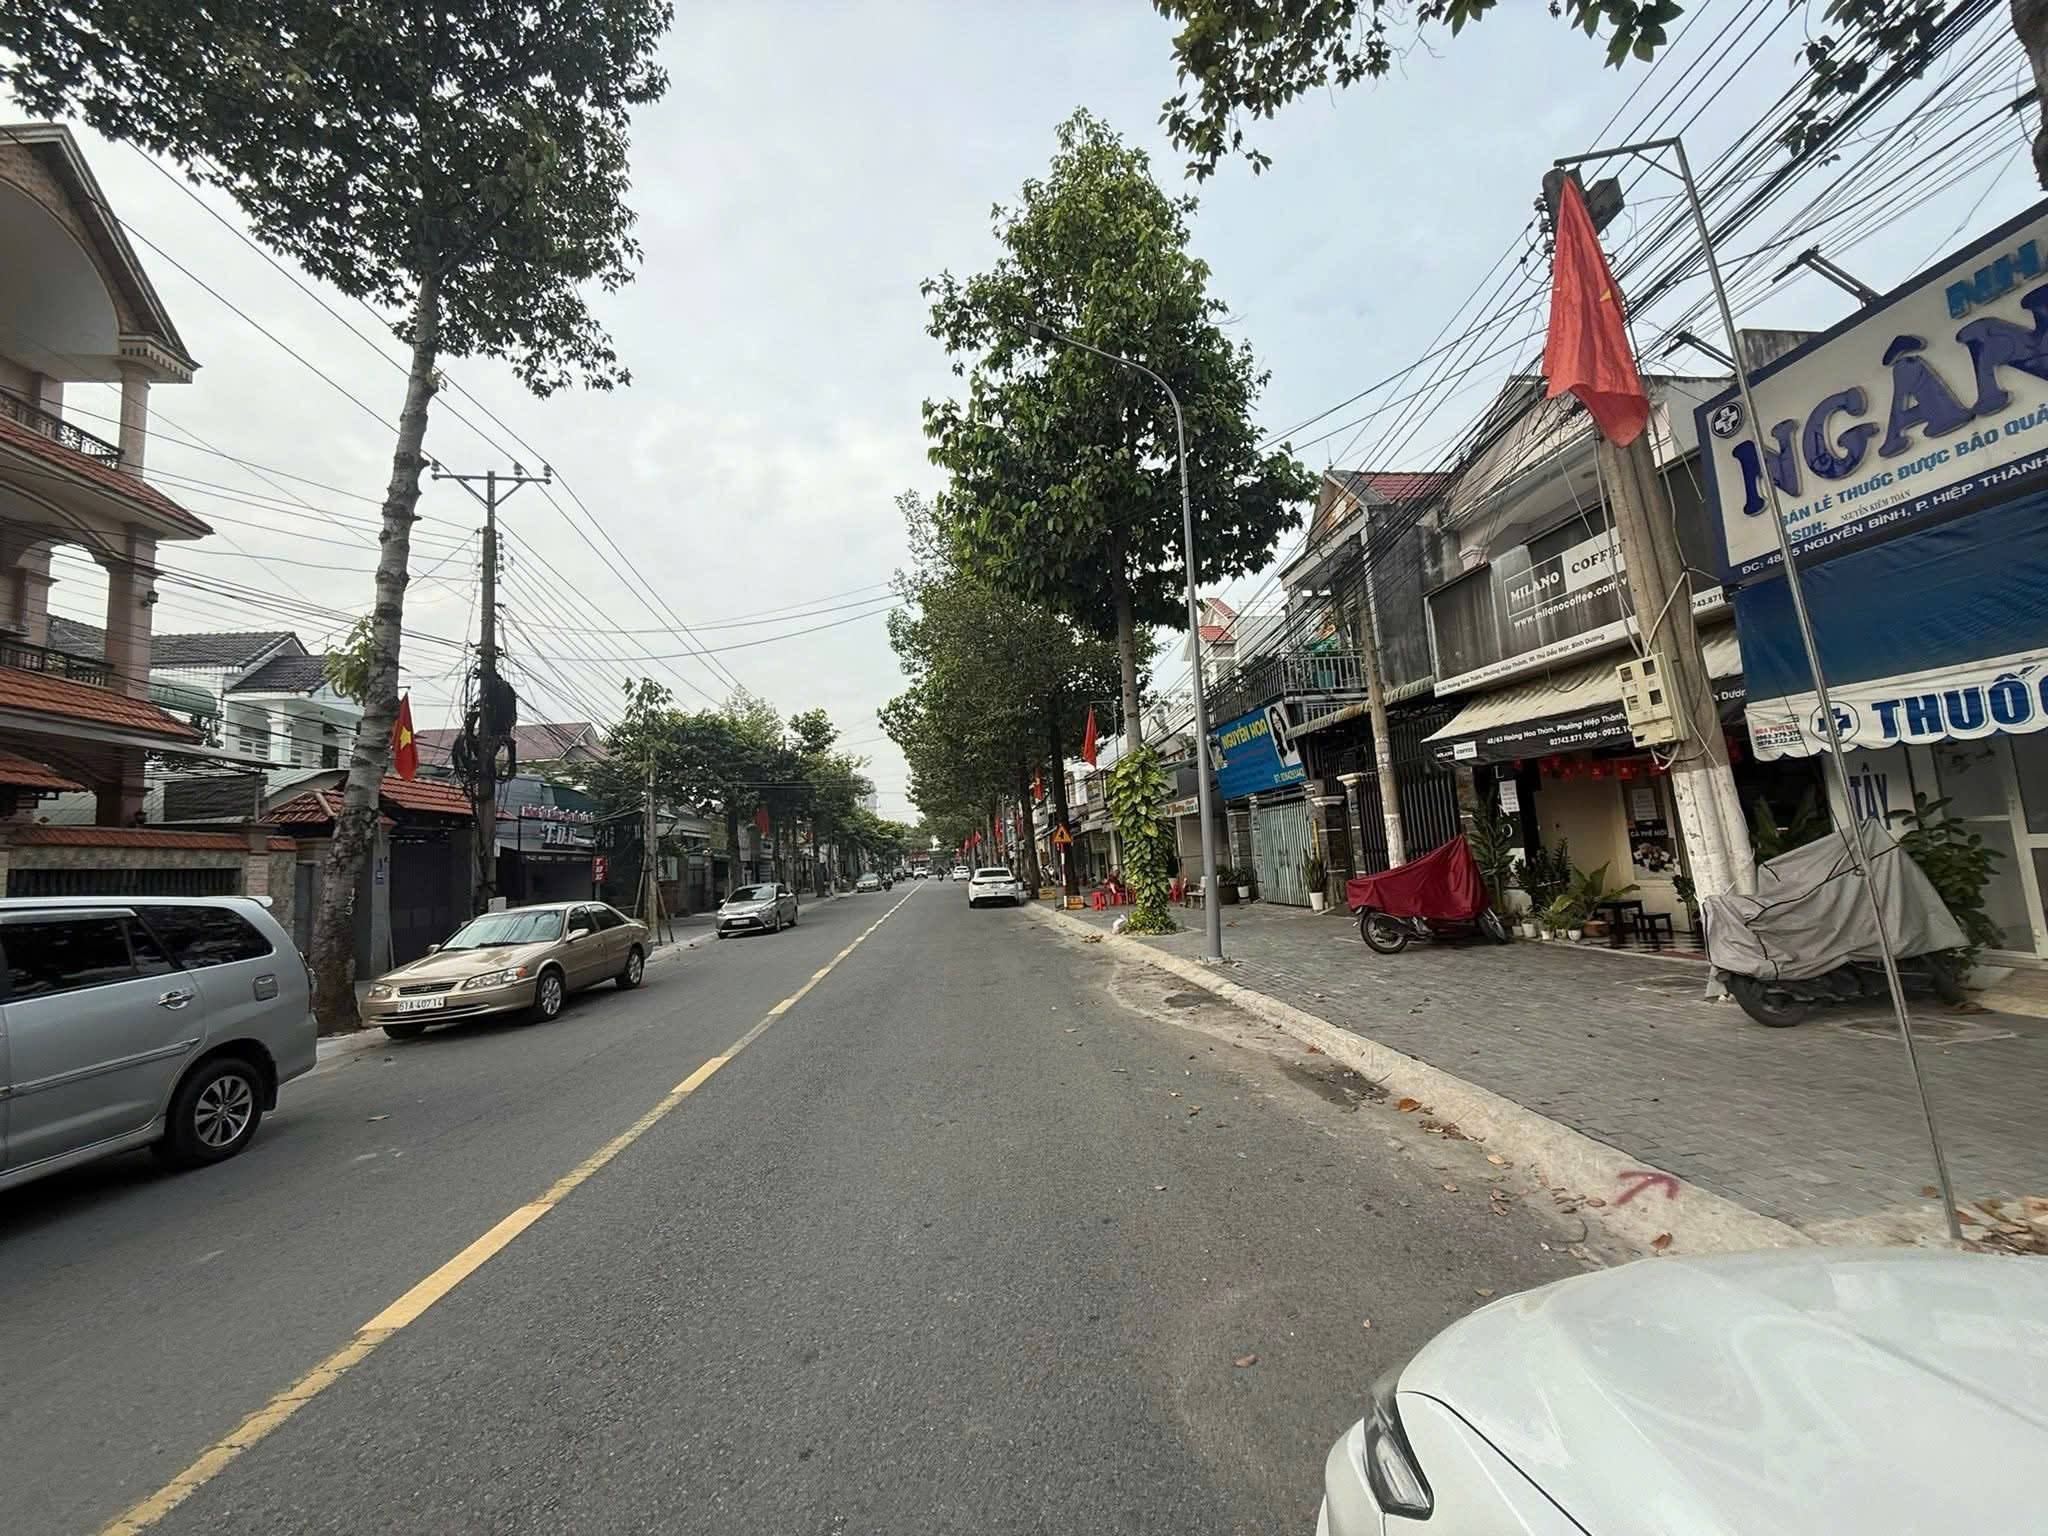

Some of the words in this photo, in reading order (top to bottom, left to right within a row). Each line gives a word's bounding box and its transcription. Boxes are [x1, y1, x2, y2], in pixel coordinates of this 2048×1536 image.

[1945, 239, 2048, 320] NH
[1837, 472, 1893, 503] THUỐC
[1897, 449, 1950, 480] ĐƯỢC
[1954, 429, 1999, 457] BẢO
[1742, 561, 1764, 575] ĐC:
[1767, 547, 1800, 566] 48/5
[1804, 523, 1863, 553] NGUYỄN
[1868, 507, 1912, 530] BÌNH,
[1915, 500, 1929, 512] P.
[1933, 484, 1975, 506] HIỆP
[1787, 521, 1829, 542] SDH:
[1510, 571, 1560, 602] MILANO
[1871, 664, 2048, 739] THUỐ
[1849, 762, 1891, 830] TÂY
